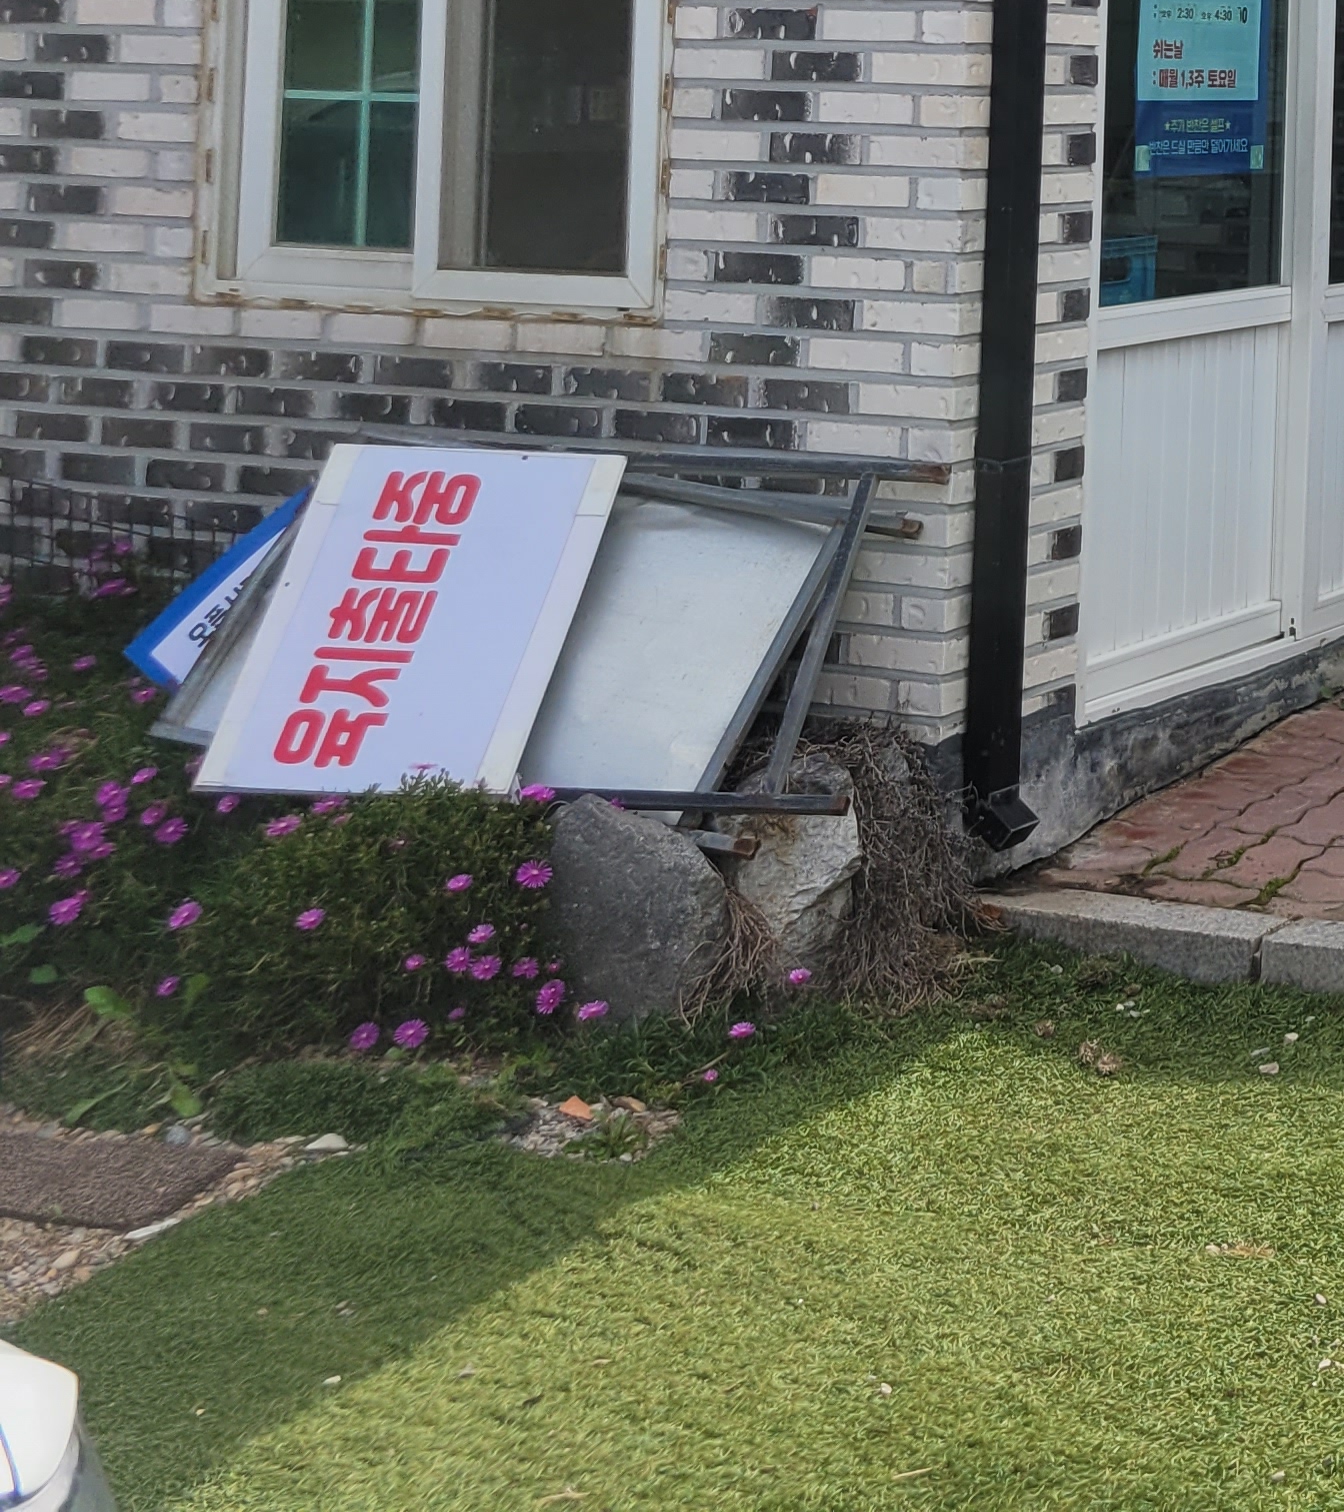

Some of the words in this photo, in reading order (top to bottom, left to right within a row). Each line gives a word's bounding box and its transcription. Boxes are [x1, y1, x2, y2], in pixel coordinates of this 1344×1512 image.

[1153, 39, 1184, 59] 쉬는날
[1180, 69, 1205, 89] 1,3주
[1207, 69, 1237, 88] 토요일
[1210, 138, 1248, 154] 덜어가세요
[273, 470, 482, 768] 육지출타중
